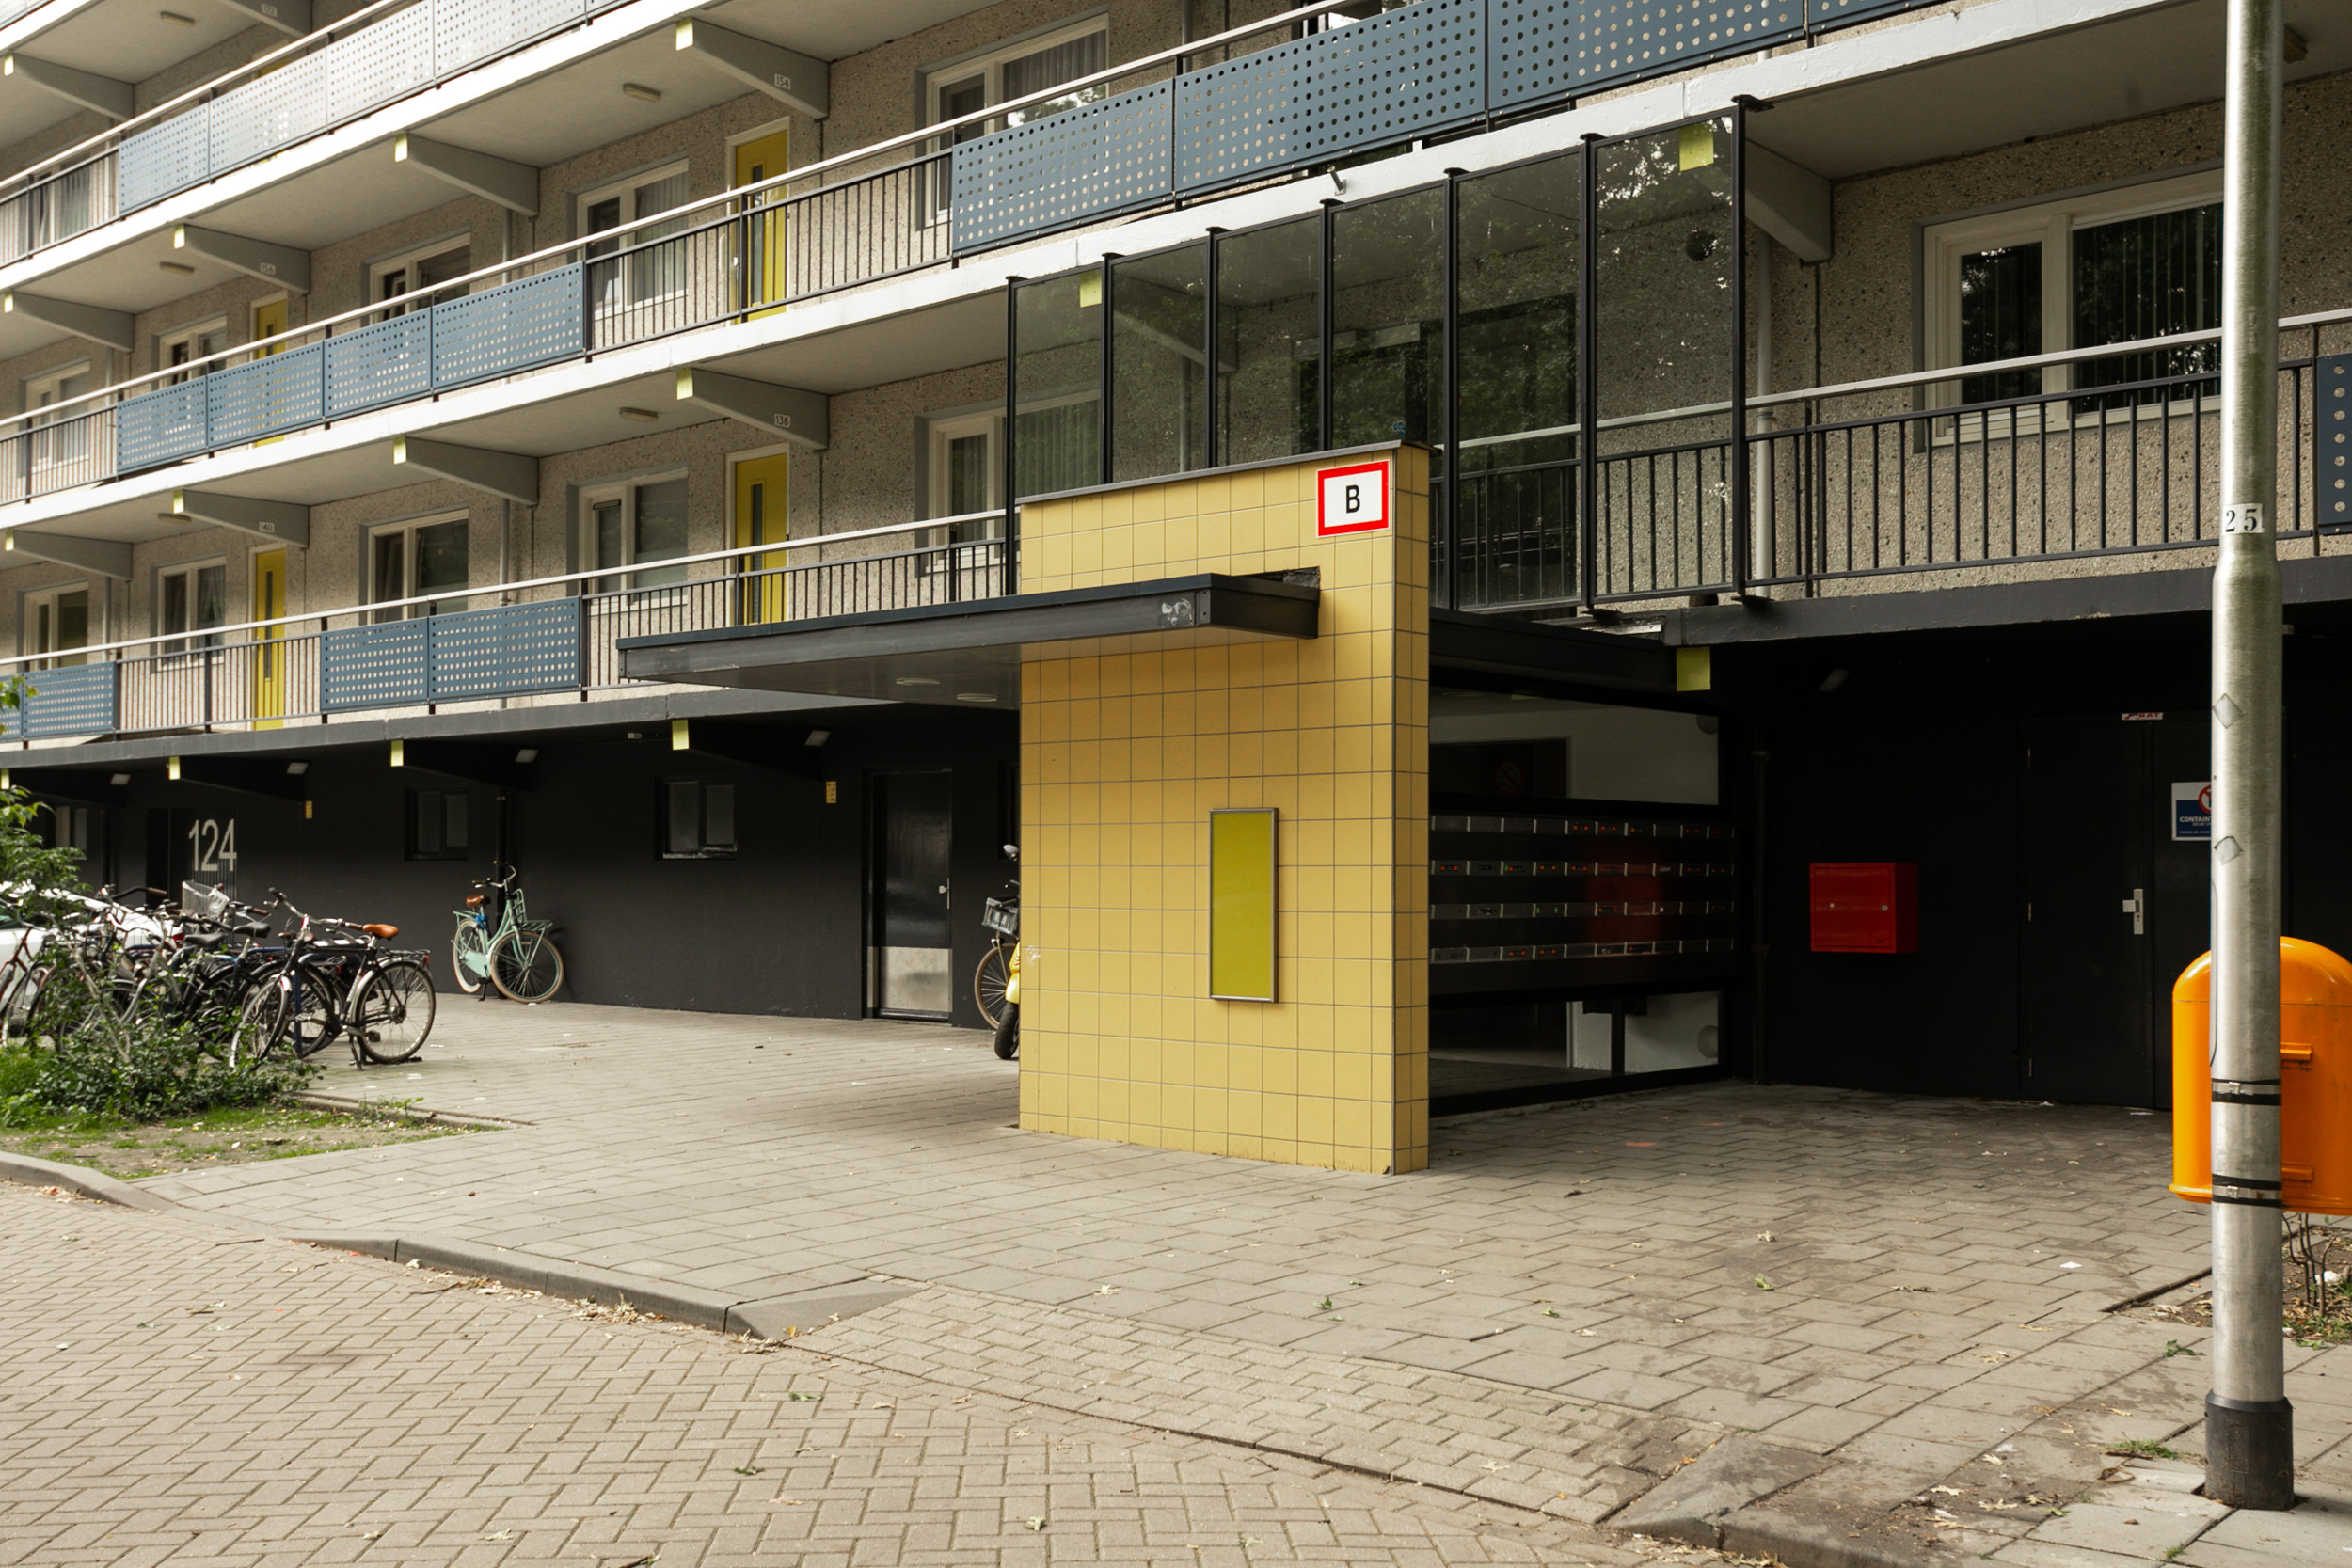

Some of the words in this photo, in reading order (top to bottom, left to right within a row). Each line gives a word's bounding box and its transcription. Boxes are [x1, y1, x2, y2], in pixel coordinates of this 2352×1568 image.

[776, 415, 789, 426] 138
[1345, 484, 1360, 514] B
[261, 523, 273, 531] 140
[188, 818, 237, 872] 124
